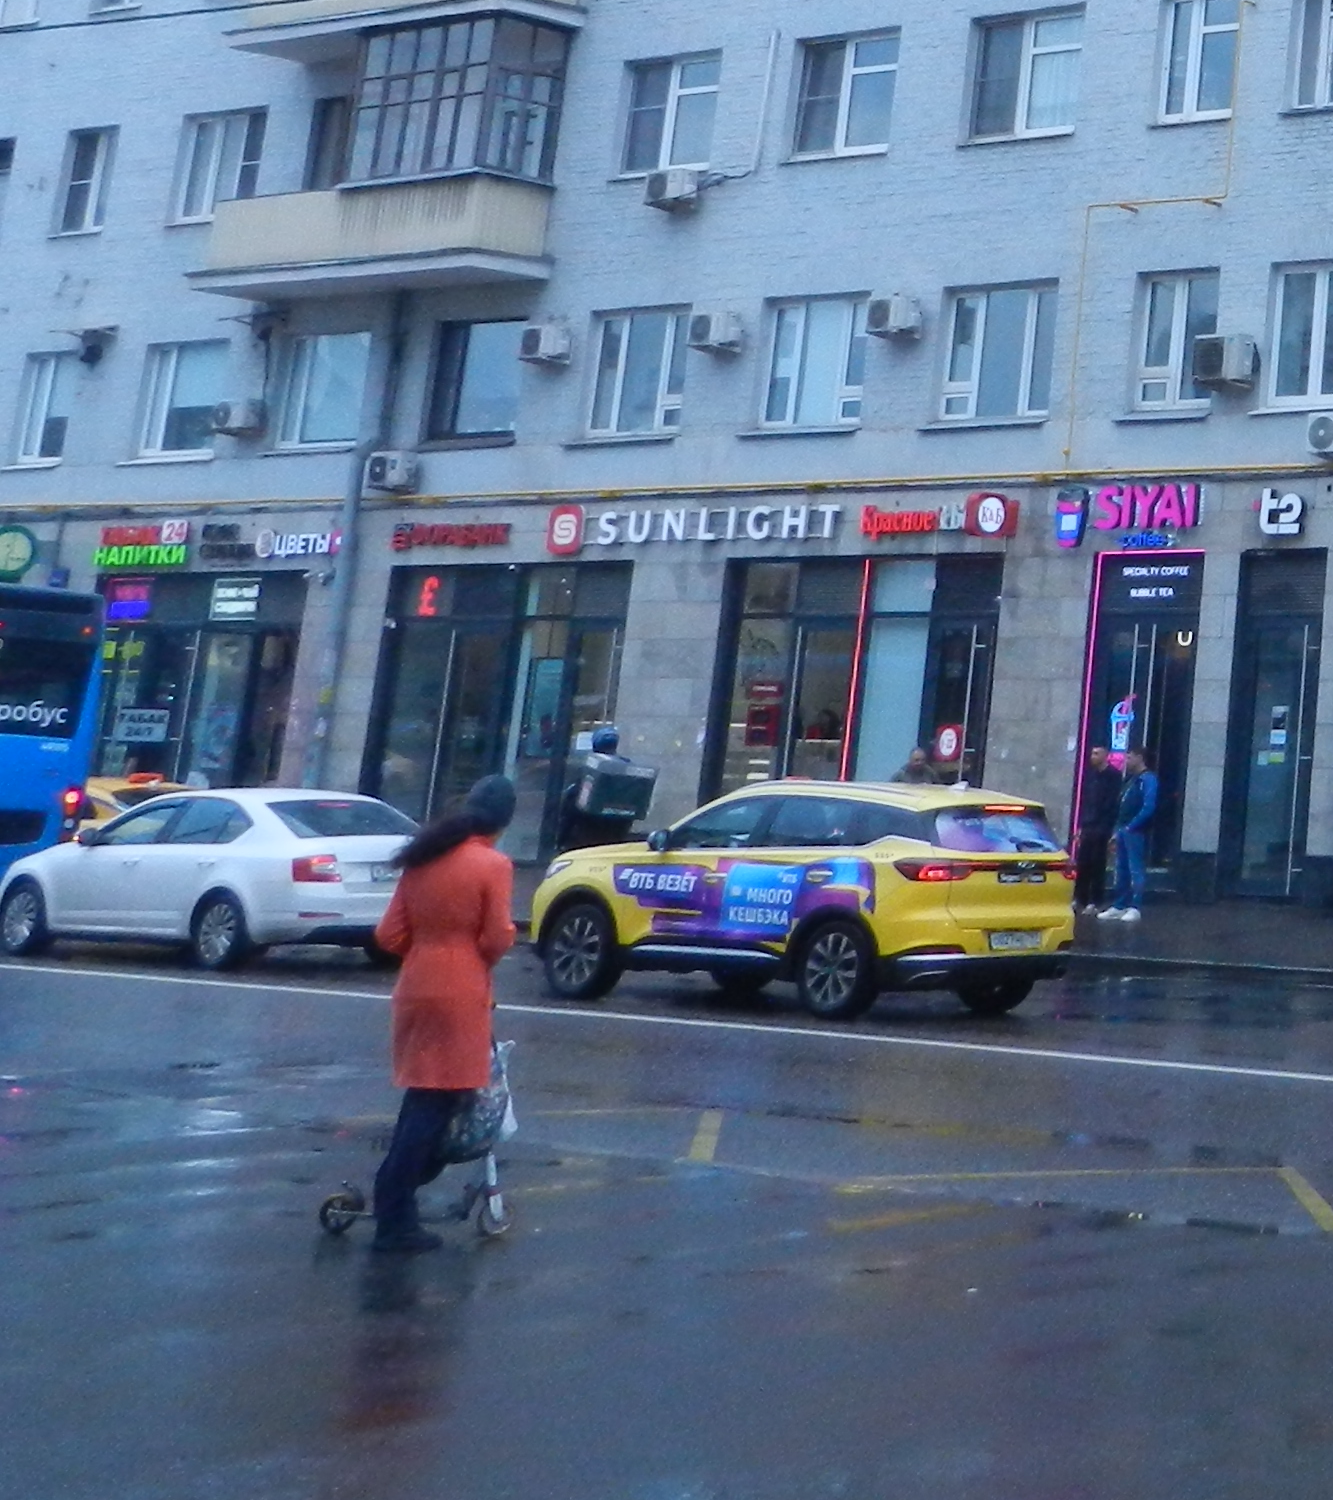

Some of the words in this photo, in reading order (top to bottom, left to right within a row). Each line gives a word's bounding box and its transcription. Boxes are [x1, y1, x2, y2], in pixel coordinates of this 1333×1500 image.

[1093, 483, 1200, 530] SIYAI
[163, 521, 187, 543] 24
[597, 503, 841, 546] SUNLIGHT
[860, 505, 937, 542] Красное
[92, 544, 187, 566] НАПИТКИ
[274, 533, 332, 558] ЦВЕТЫ
[1159, 587, 1174, 597] TEA
[629, 872, 654, 889] ВТБ
[746, 887, 793, 905] МНОГО
[729, 906, 790, 926] КЕШБЭКА
